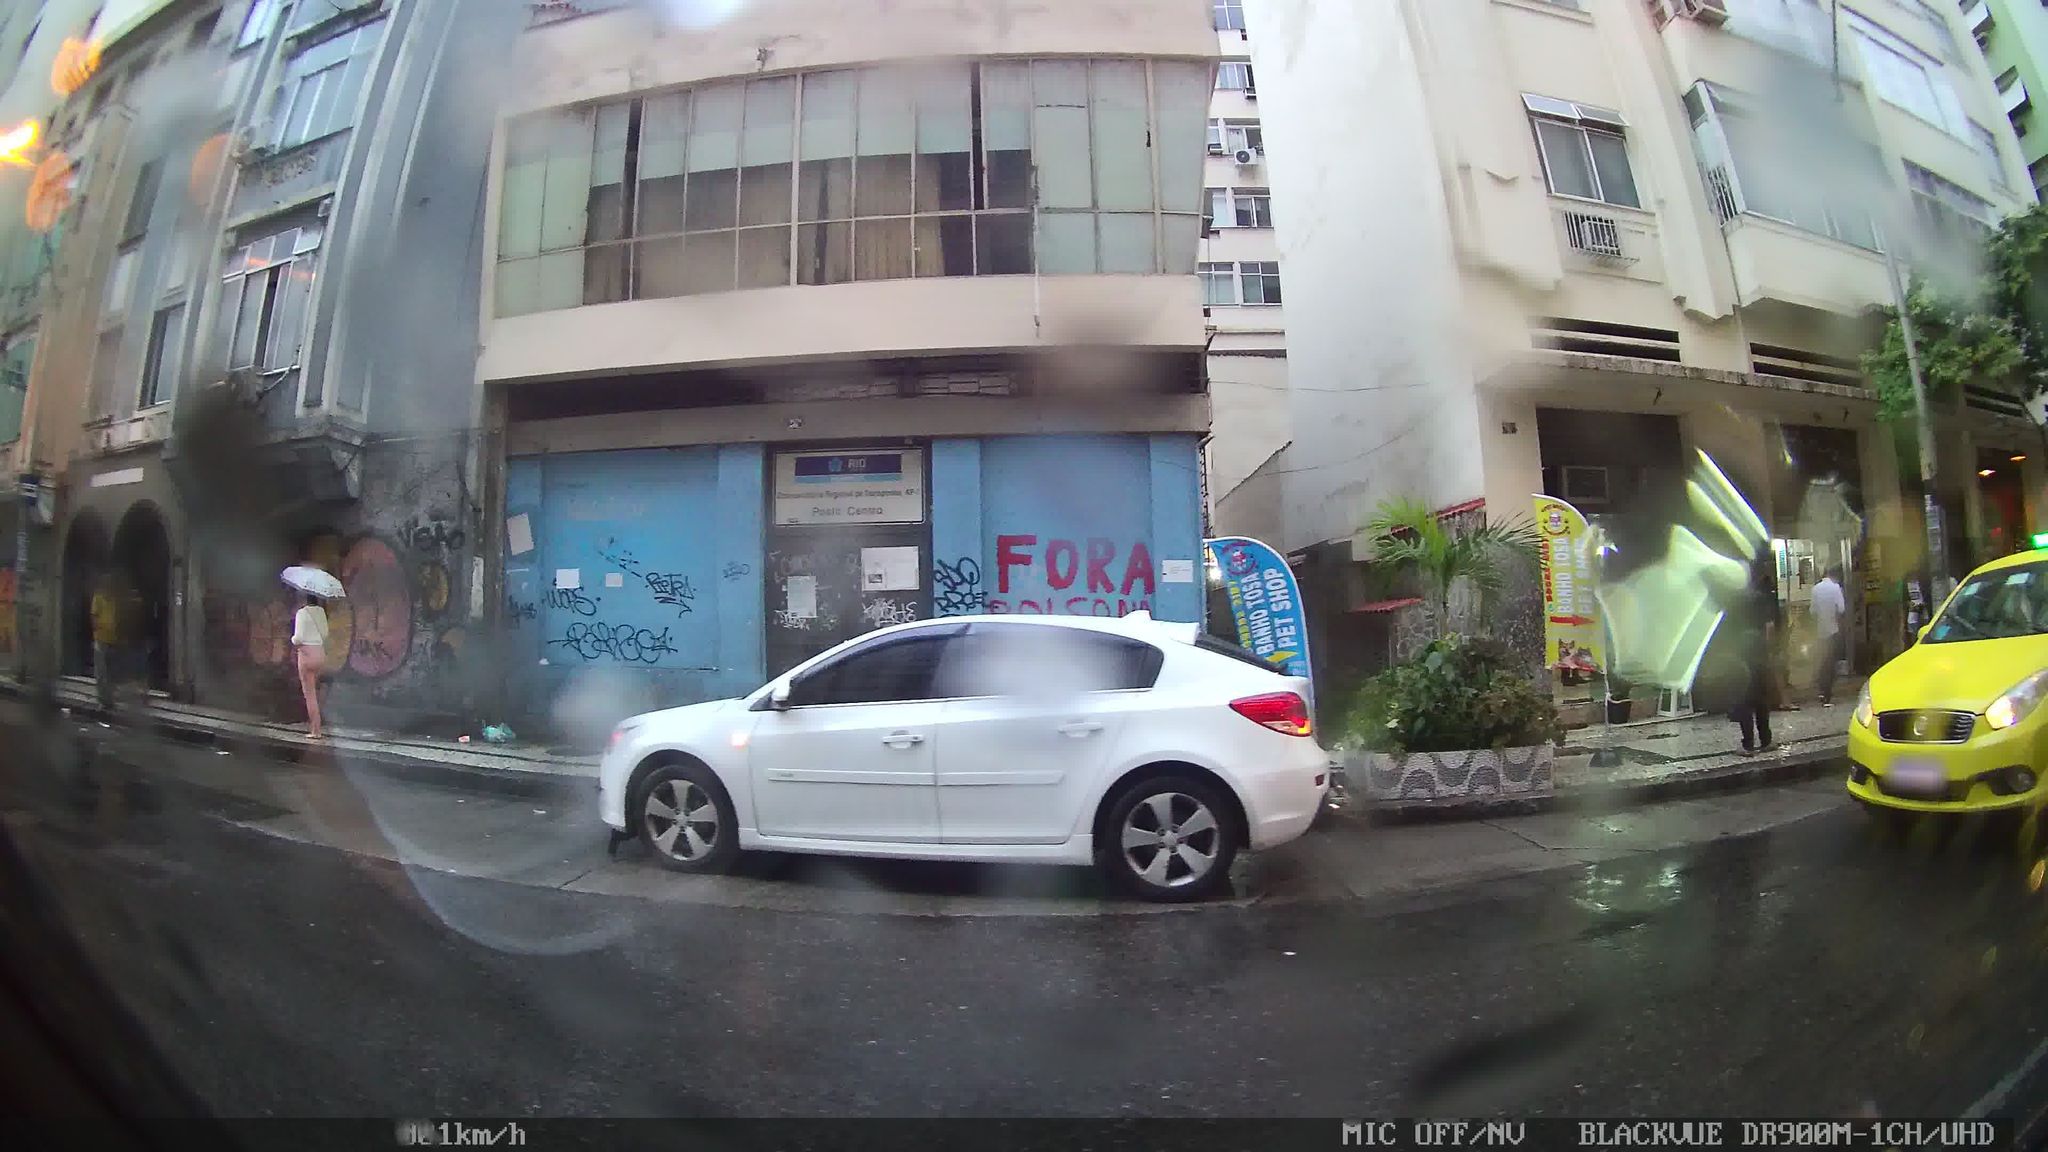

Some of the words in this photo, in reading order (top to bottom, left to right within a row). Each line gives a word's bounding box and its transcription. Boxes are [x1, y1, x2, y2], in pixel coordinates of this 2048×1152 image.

[848, 457, 867, 469] RIO
[997, 533, 1156, 595] FORA
[1240, 572, 1266, 610] TOSA
[1263, 568, 1293, 612] SHOP
[1249, 609, 1275, 655] BANHO
[1274, 617, 1297, 649] PET
